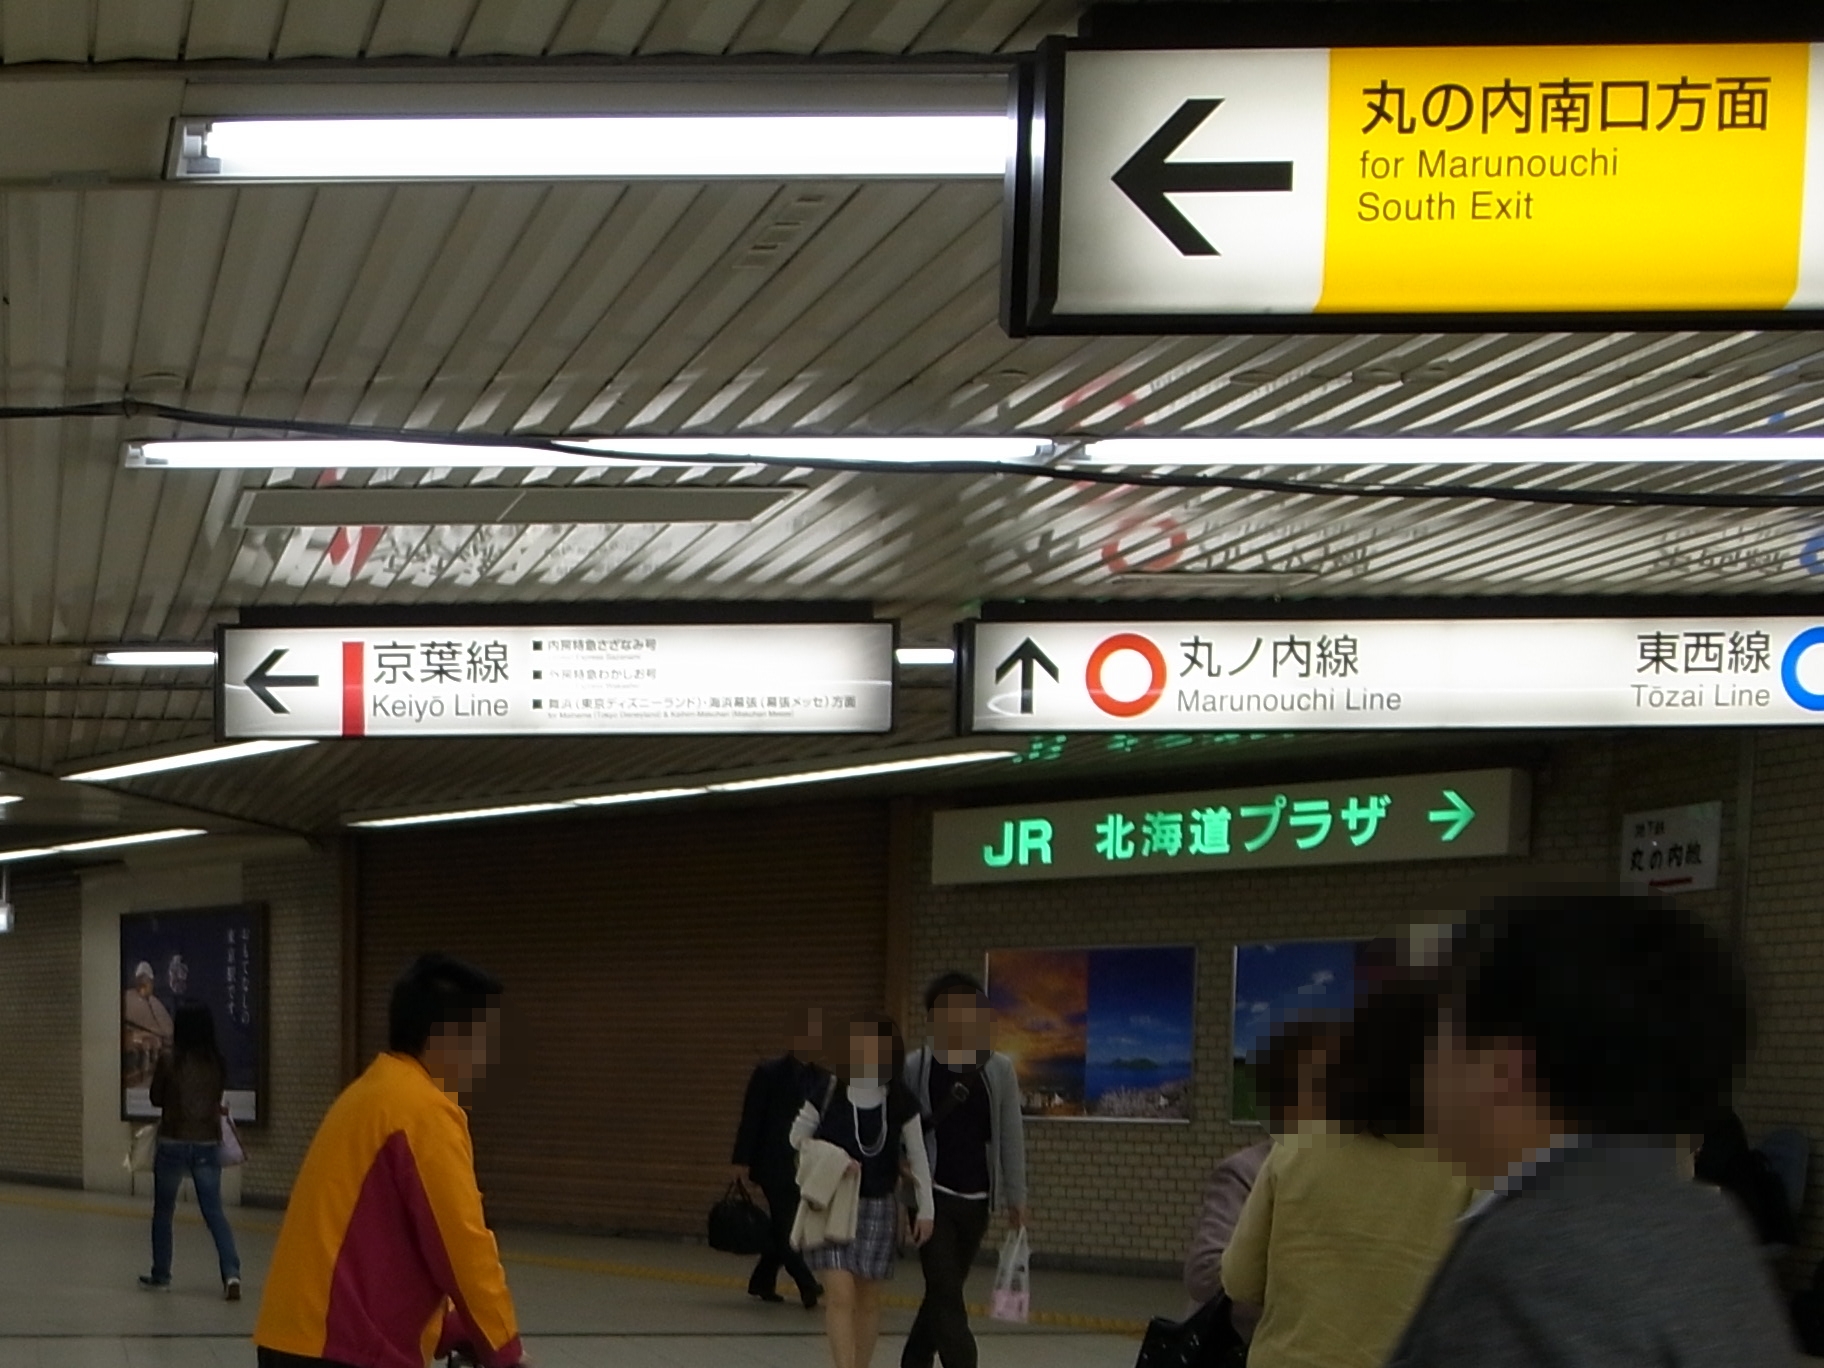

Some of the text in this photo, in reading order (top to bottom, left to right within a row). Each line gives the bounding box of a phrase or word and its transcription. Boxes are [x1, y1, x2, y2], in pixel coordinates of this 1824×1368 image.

[1360, 76, 1772, 136] 丸の内南口方面
[1360, 146, 1619, 180] for Marunouchi
[1357, 190, 1534, 223] South Exit
[371, 640, 510, 686] 京葉線
[1178, 629, 1771, 679] 丸ノ内線 東西線
[371, 693, 509, 725] Keiyō Line
[1177, 681, 1771, 714] Marunouchi Line Tōzai Line
[984, 795, 1391, 868] JR 北海道プラザ
